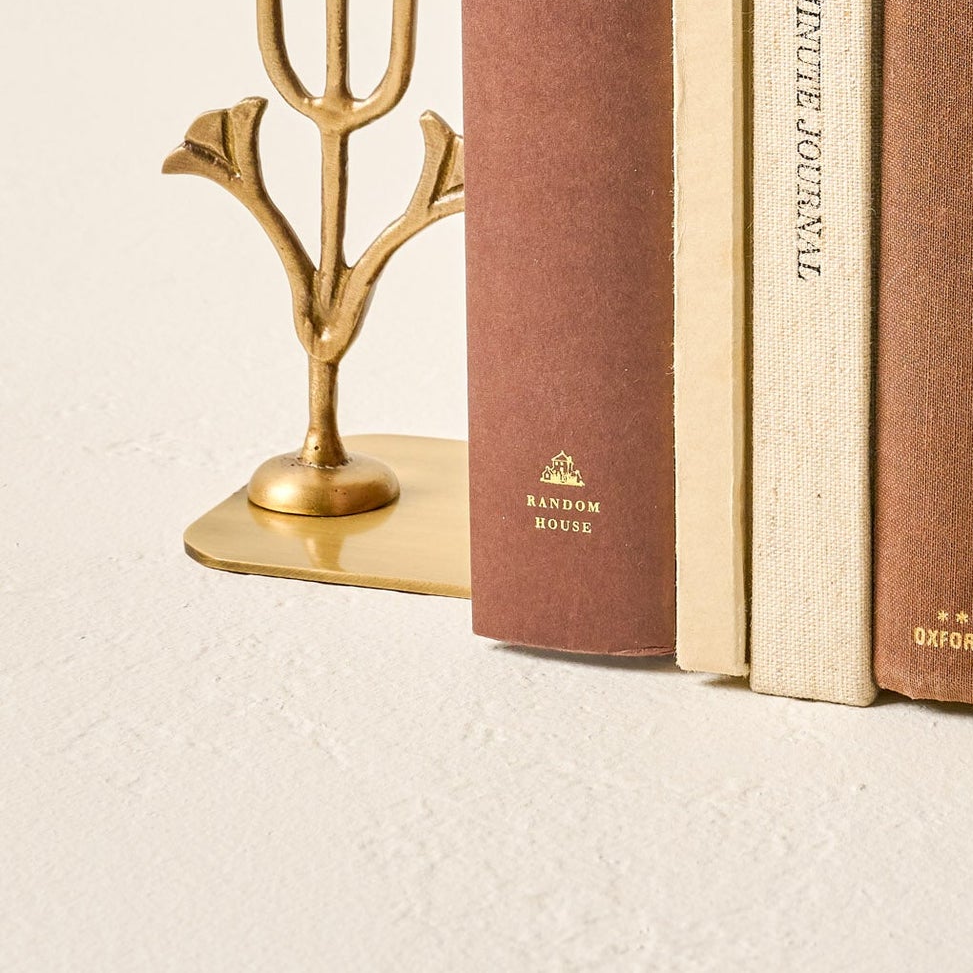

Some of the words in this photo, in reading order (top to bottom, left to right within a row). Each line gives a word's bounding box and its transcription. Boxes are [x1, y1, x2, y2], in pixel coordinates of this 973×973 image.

[795, 118, 822, 281] JOURNAL
[526, 494, 601, 514] RANDOM
[534, 516, 592, 534] HOUSE
